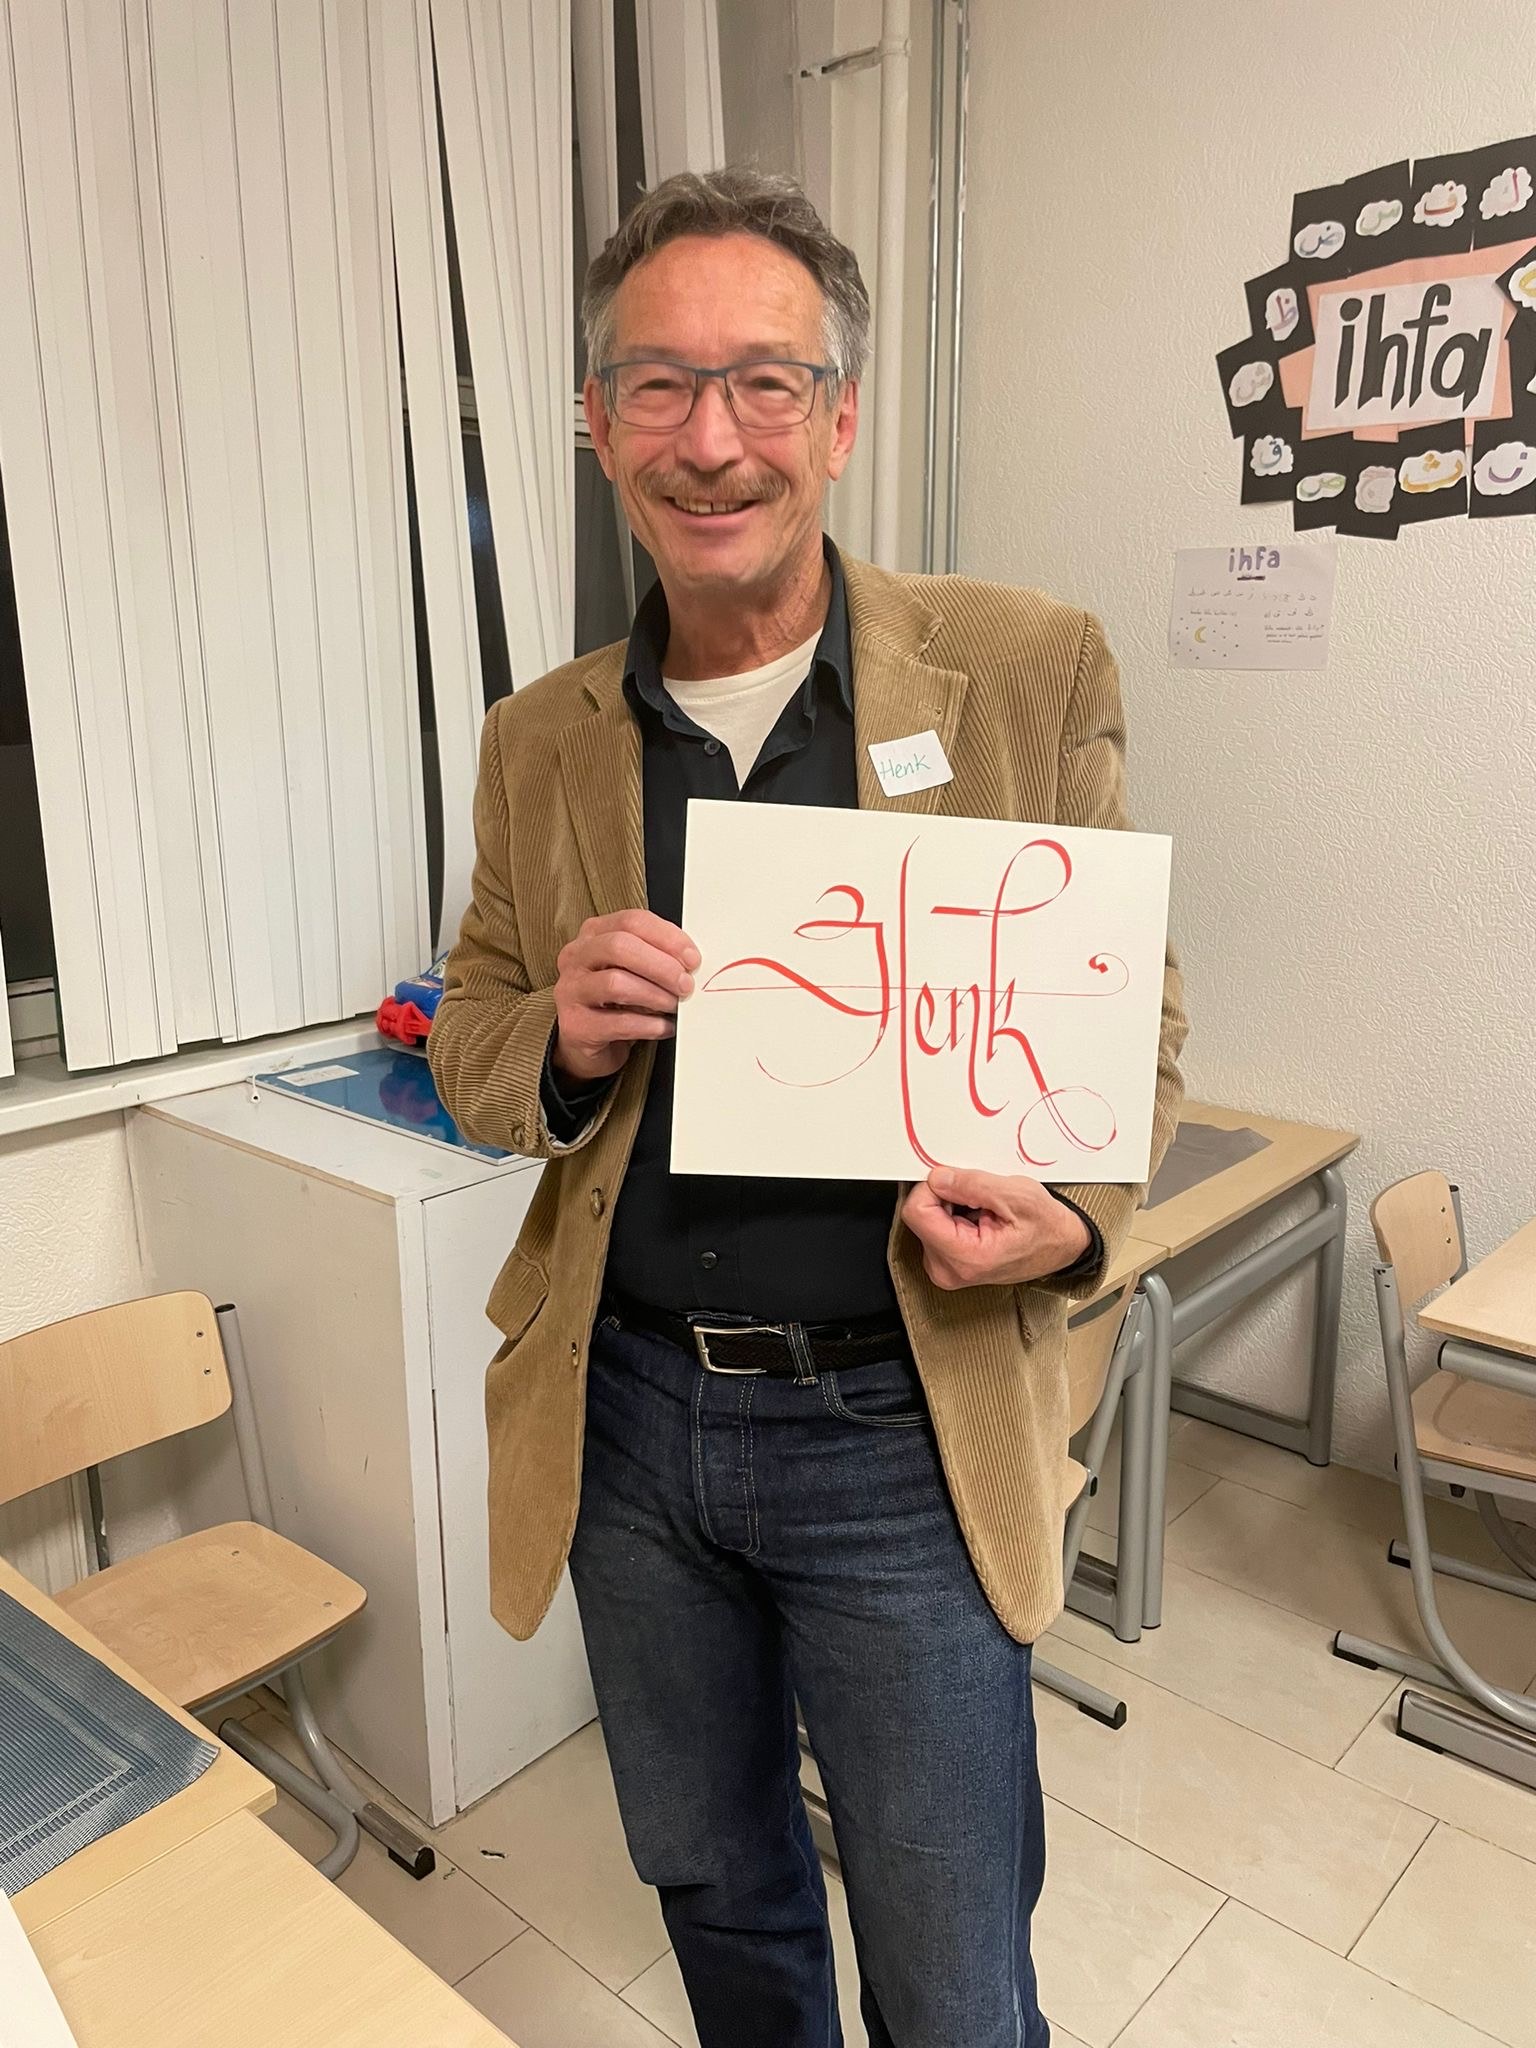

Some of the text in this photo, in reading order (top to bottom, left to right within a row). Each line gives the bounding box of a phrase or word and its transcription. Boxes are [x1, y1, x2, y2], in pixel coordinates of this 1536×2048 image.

[1333, 283, 1492, 411] ihfa
[1229, 546, 1280, 573] ihfa
[880, 753, 931, 780] Henk
